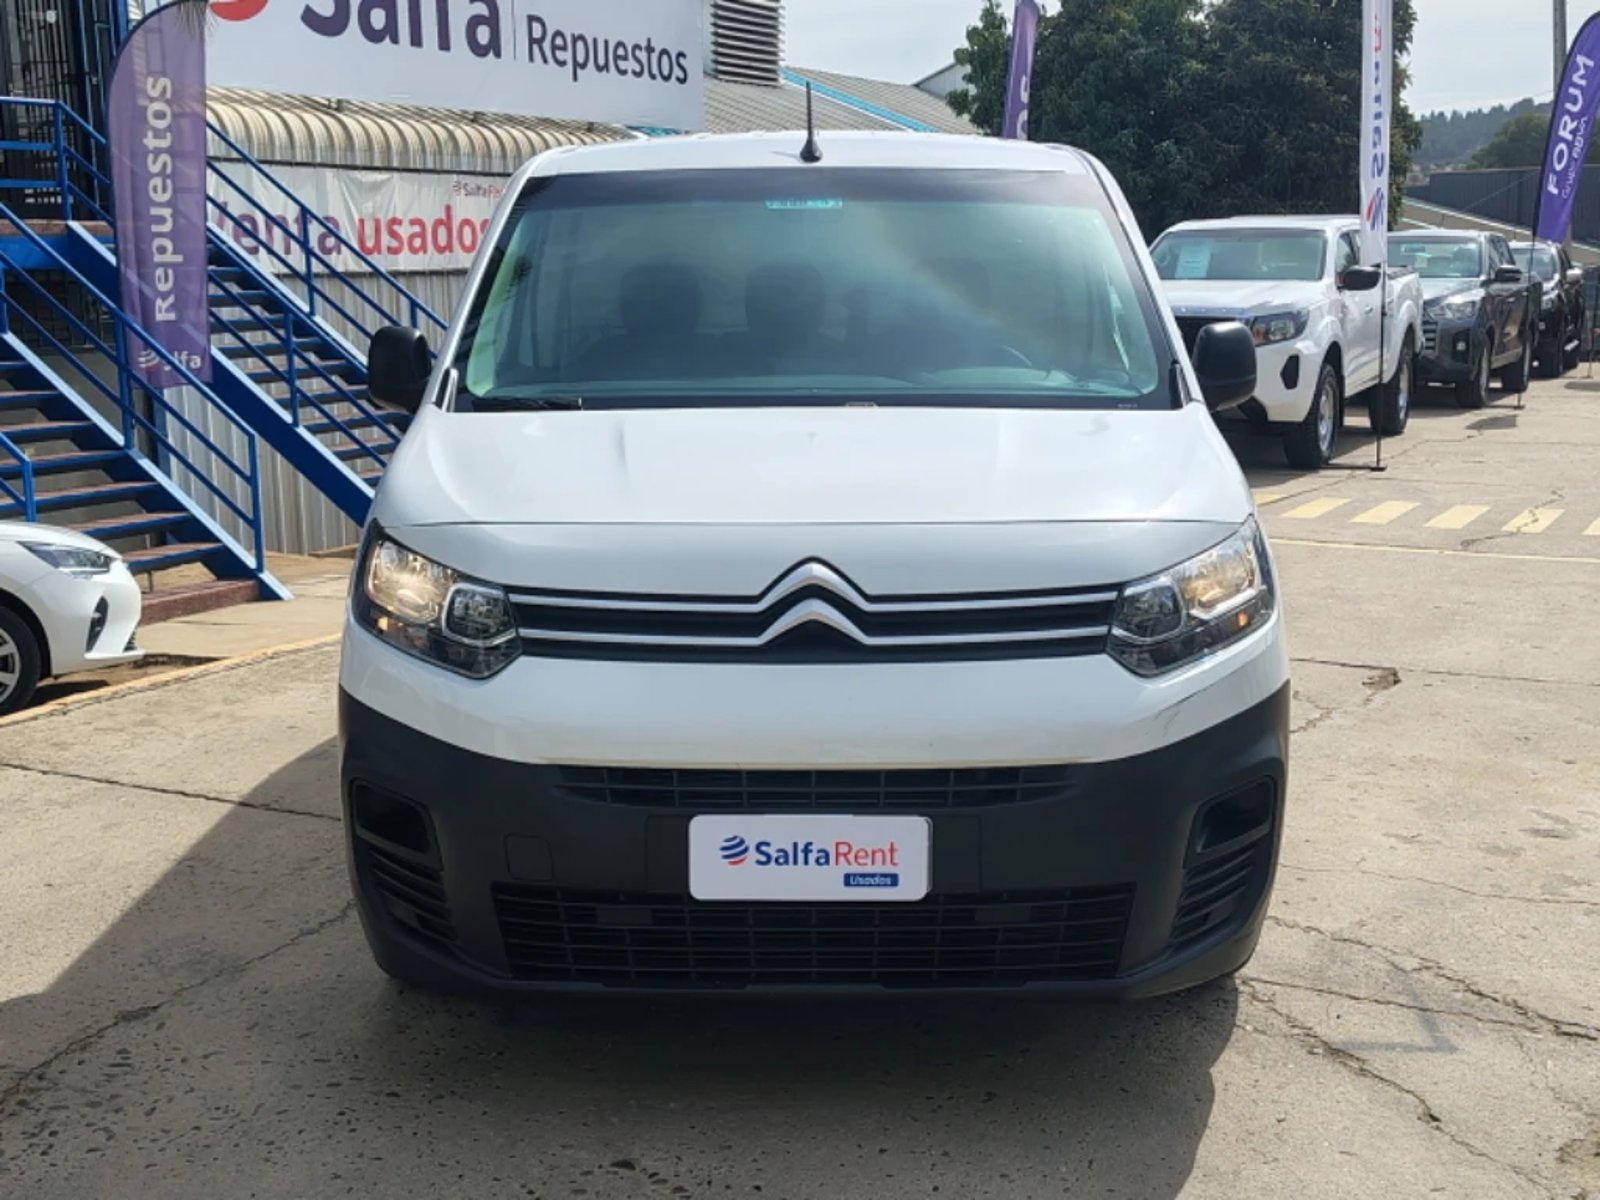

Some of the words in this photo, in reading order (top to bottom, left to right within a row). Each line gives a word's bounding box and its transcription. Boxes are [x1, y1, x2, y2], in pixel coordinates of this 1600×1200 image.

[526, 14, 688, 84] Repuestos
[1547, 54, 1595, 196] FORUM
[143, 76, 184, 322] Repuestos
[163, 350, 202, 371] lfa
[754, 841, 899, 867] SalfaRent
